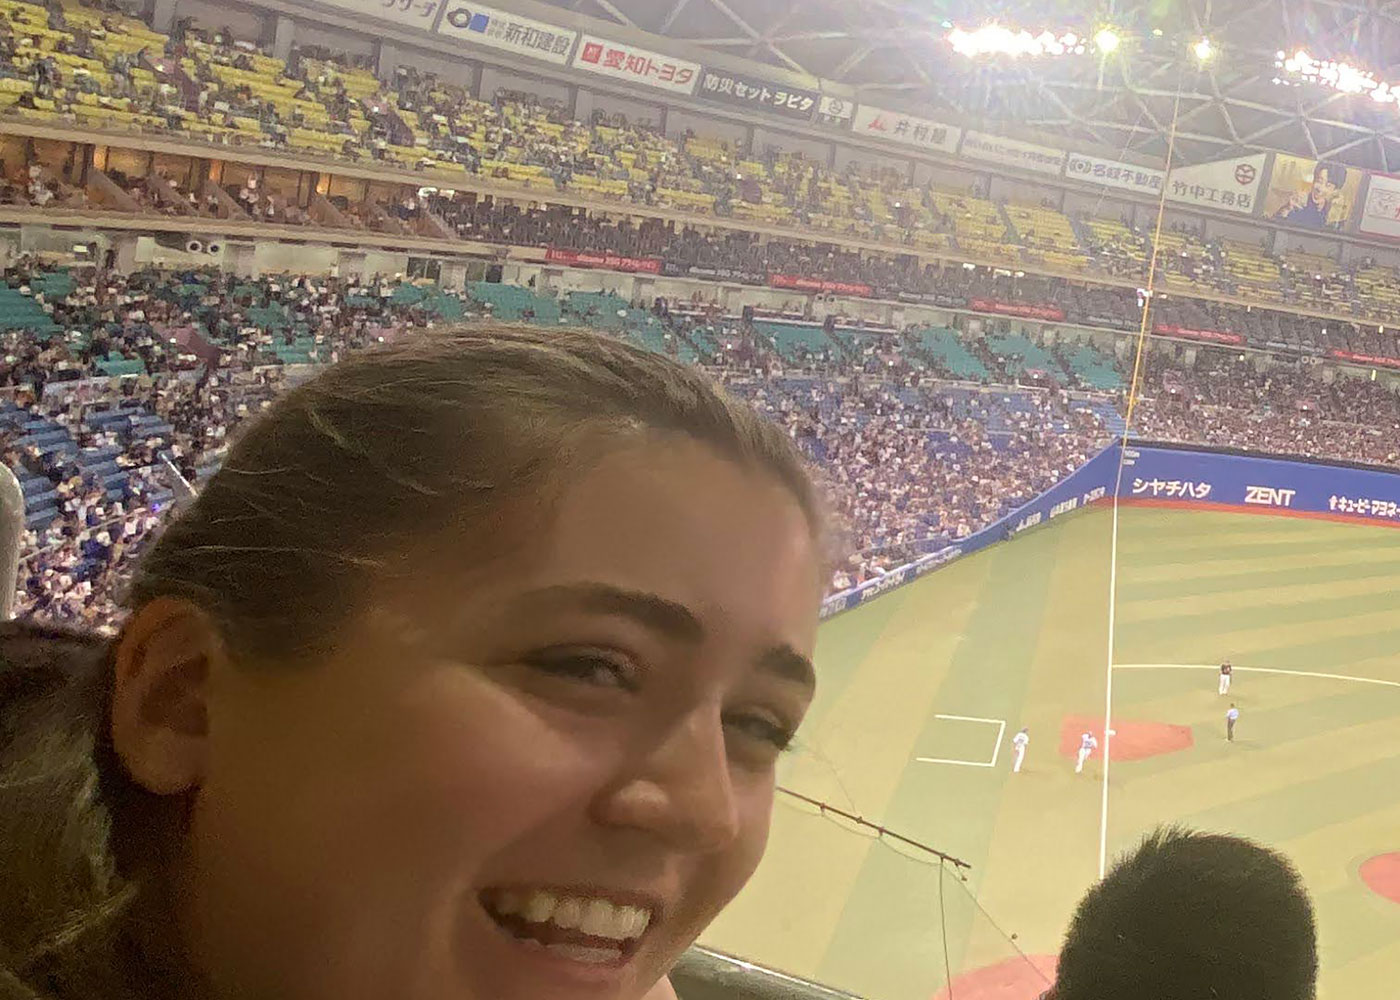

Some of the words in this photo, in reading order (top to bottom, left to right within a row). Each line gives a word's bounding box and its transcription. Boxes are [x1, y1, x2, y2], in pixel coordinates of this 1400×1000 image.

[603, 49, 694, 84] 愛知トヨタ
[1172, 180, 1252, 208] 竹中工務店
[1245, 485, 1296, 507] ZENT
